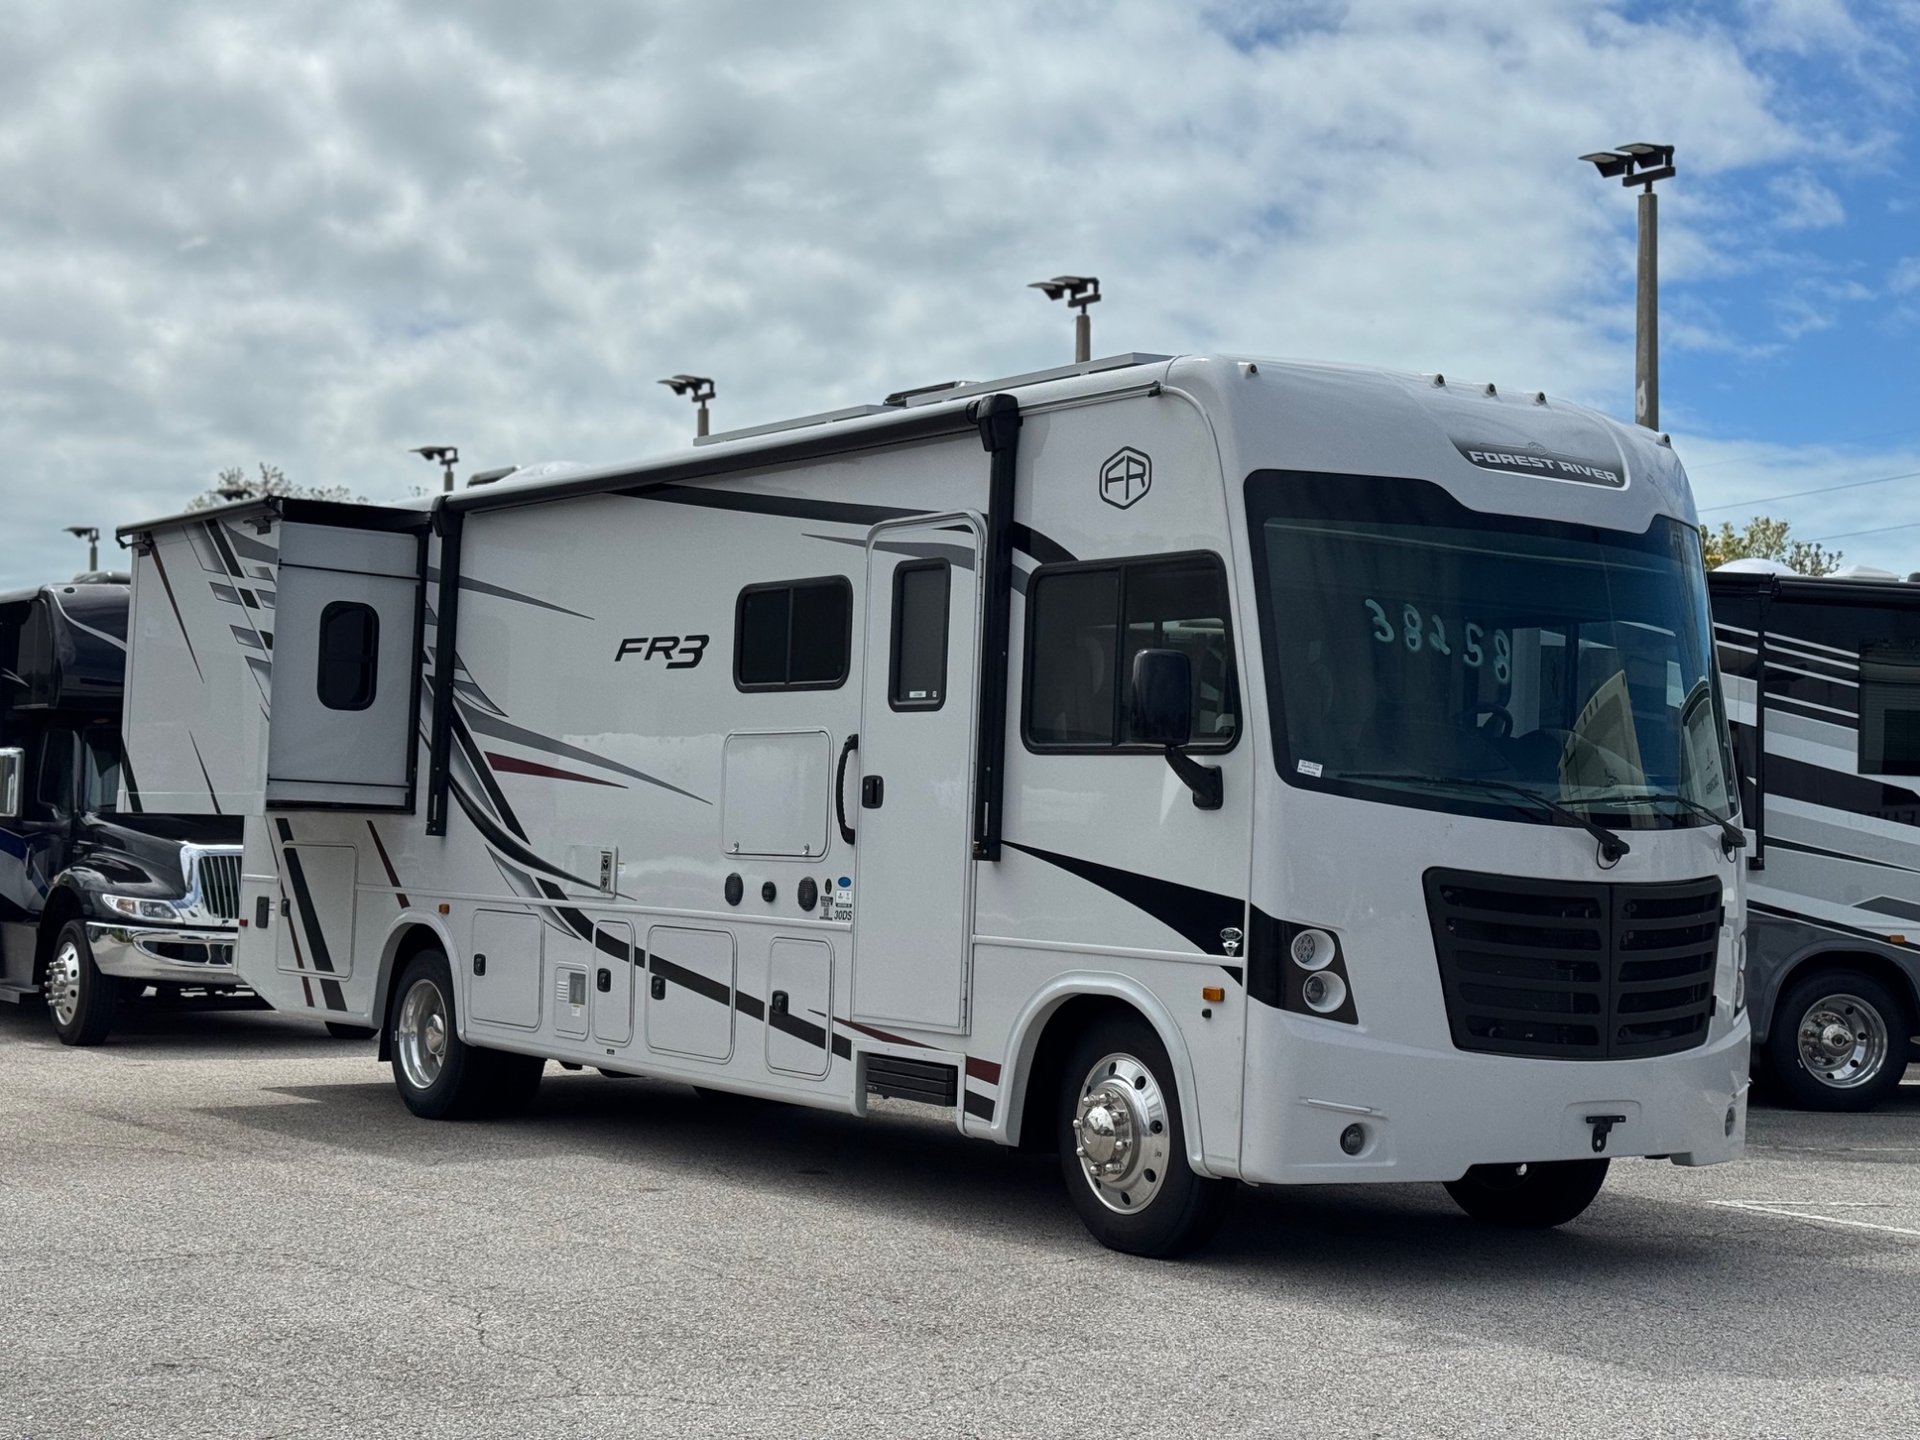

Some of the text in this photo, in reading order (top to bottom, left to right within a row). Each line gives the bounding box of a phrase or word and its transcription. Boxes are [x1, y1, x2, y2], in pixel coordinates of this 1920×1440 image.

[1467, 450, 1620, 484] FOREST RIVER
[614, 634, 710, 670] FR3
[1364, 598, 1511, 684] 38258
[834, 909, 853, 921] 30DS
